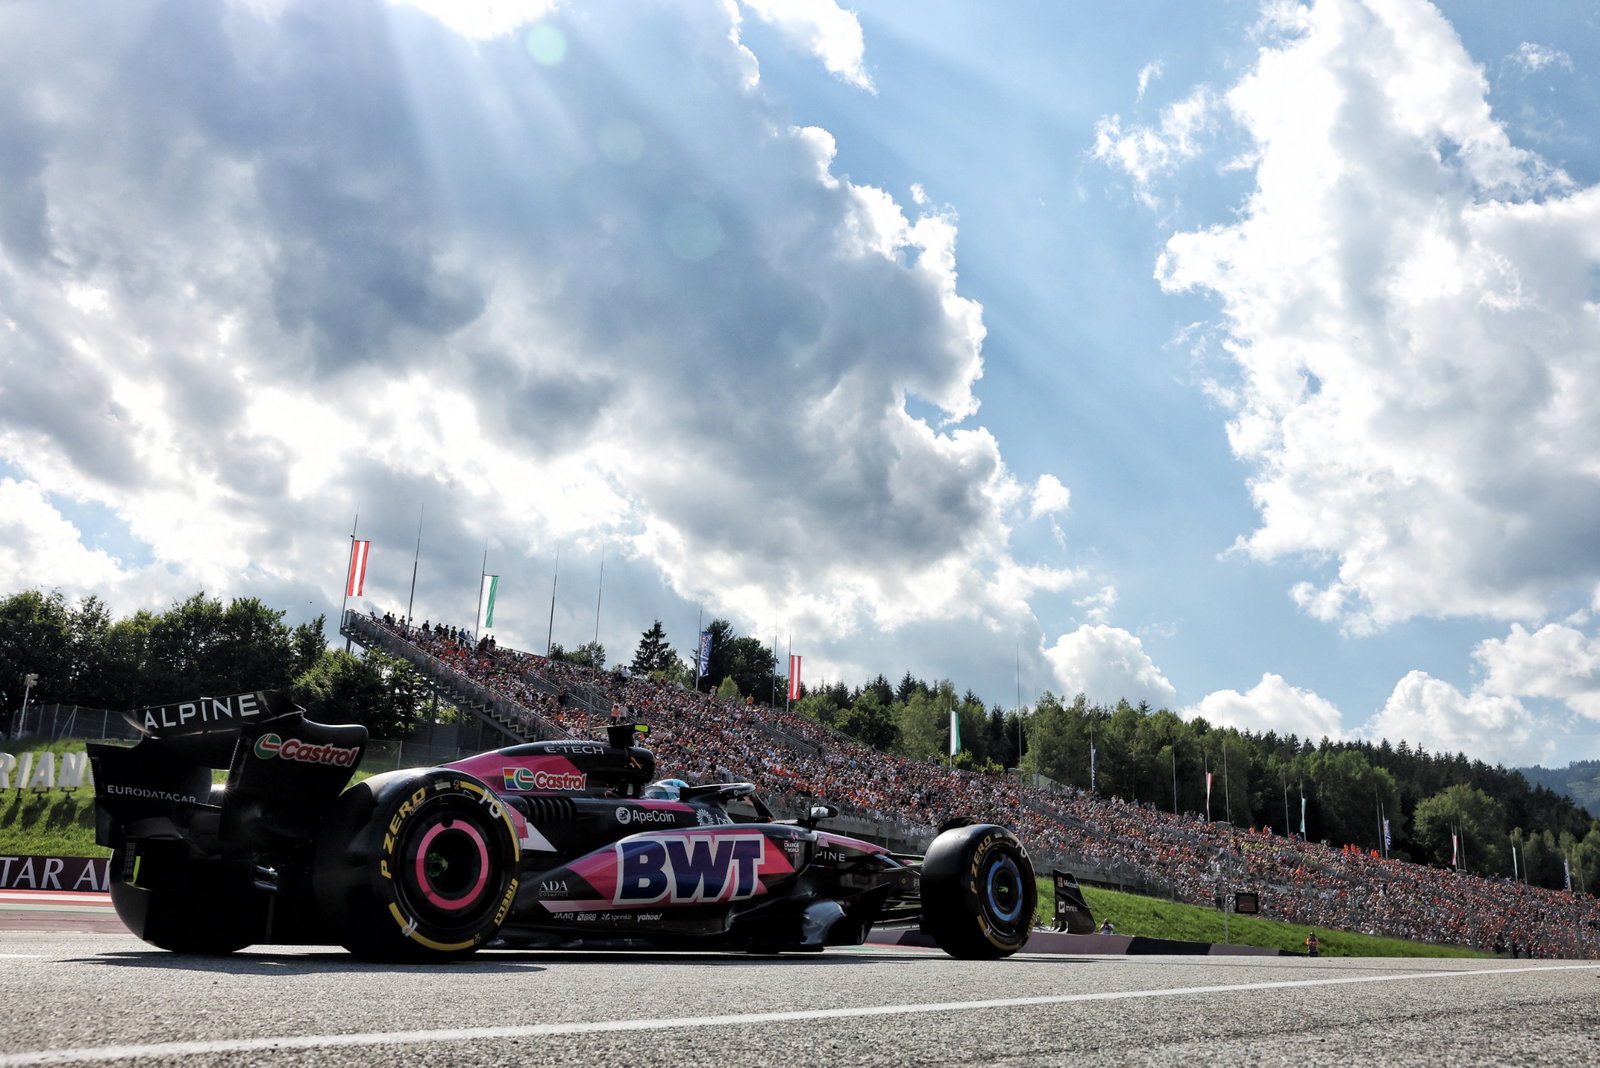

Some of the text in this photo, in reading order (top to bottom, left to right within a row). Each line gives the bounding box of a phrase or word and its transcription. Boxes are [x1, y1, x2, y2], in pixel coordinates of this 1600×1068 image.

[144, 694, 260, 729] ALPINE
[280, 739, 360, 768] Castrol
[544, 745, 605, 755] E-TECH
[107, 784, 197, 804] EURODATACAR
[534, 770, 588, 791] Castrol
[632, 809, 676, 824] ApeCoin
[381, 787, 426, 879] P ZERO
[612, 834, 765, 906] BWT
[971, 835, 992, 878] ZERO
[0, 857, 64, 890] TAR
[539, 880, 568, 891] ADA
